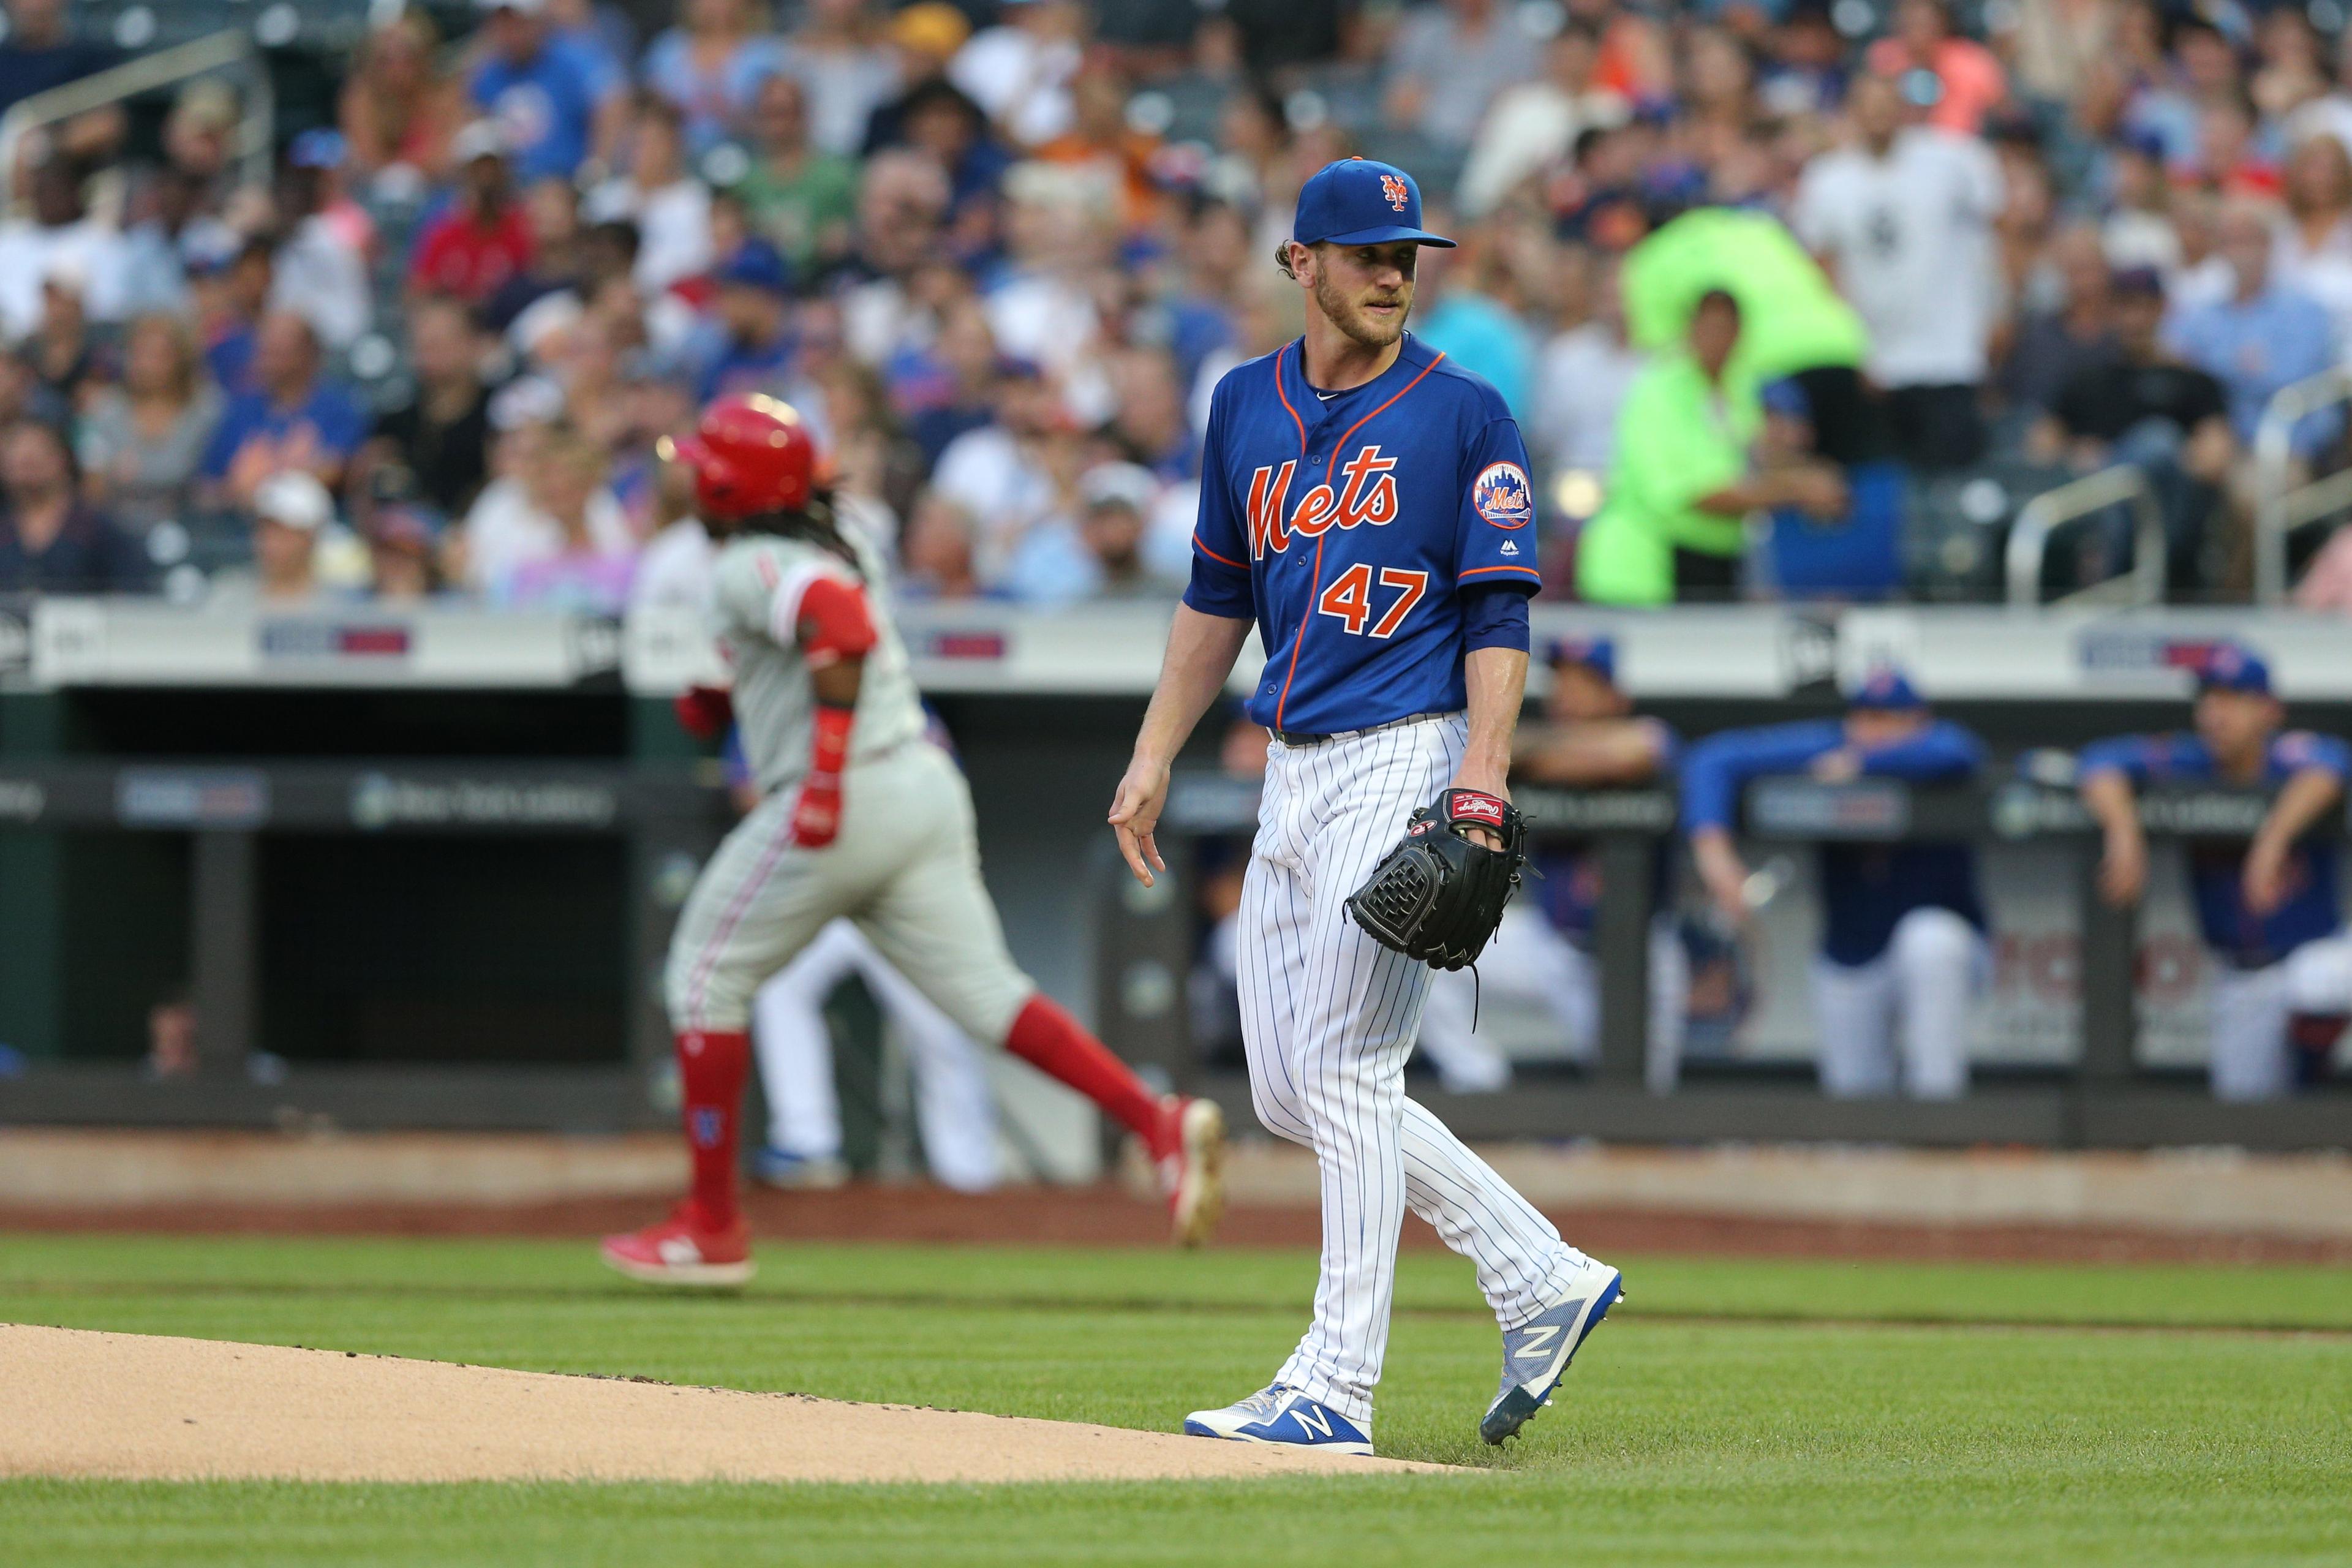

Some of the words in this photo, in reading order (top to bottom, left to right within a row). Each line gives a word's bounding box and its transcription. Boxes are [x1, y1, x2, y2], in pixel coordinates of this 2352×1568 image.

[1246, 445, 1399, 563] Mets
[1485, 487, 1525, 510] Mets
[1318, 562, 1429, 639] 47
[1457, 801, 1499, 815] Rawlings
